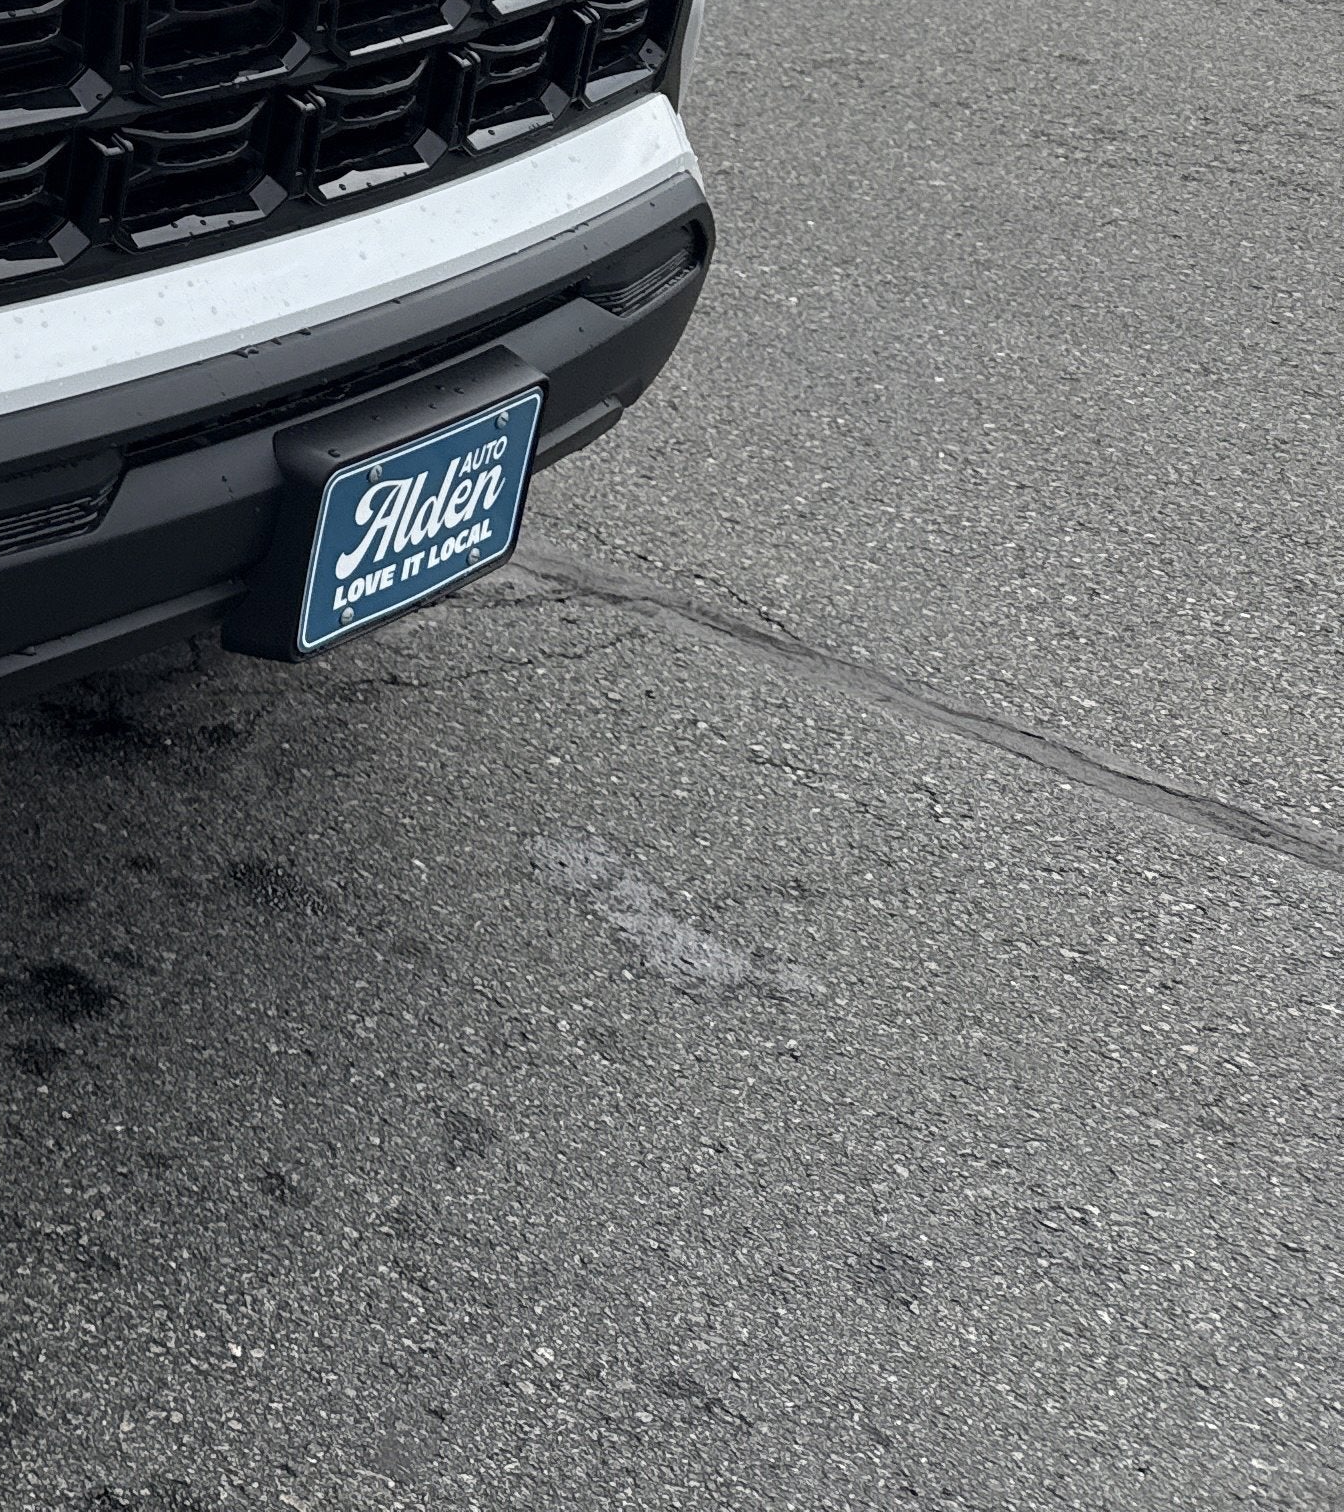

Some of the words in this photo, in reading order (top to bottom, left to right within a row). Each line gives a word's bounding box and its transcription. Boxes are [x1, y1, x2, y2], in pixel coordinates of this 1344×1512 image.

[459, 435, 508, 477] AUTO
[332, 563, 397, 611] LOVE
[401, 550, 426, 581] IT
[427, 518, 493, 569] LOCAL
[335, 457, 506, 580] Alden
